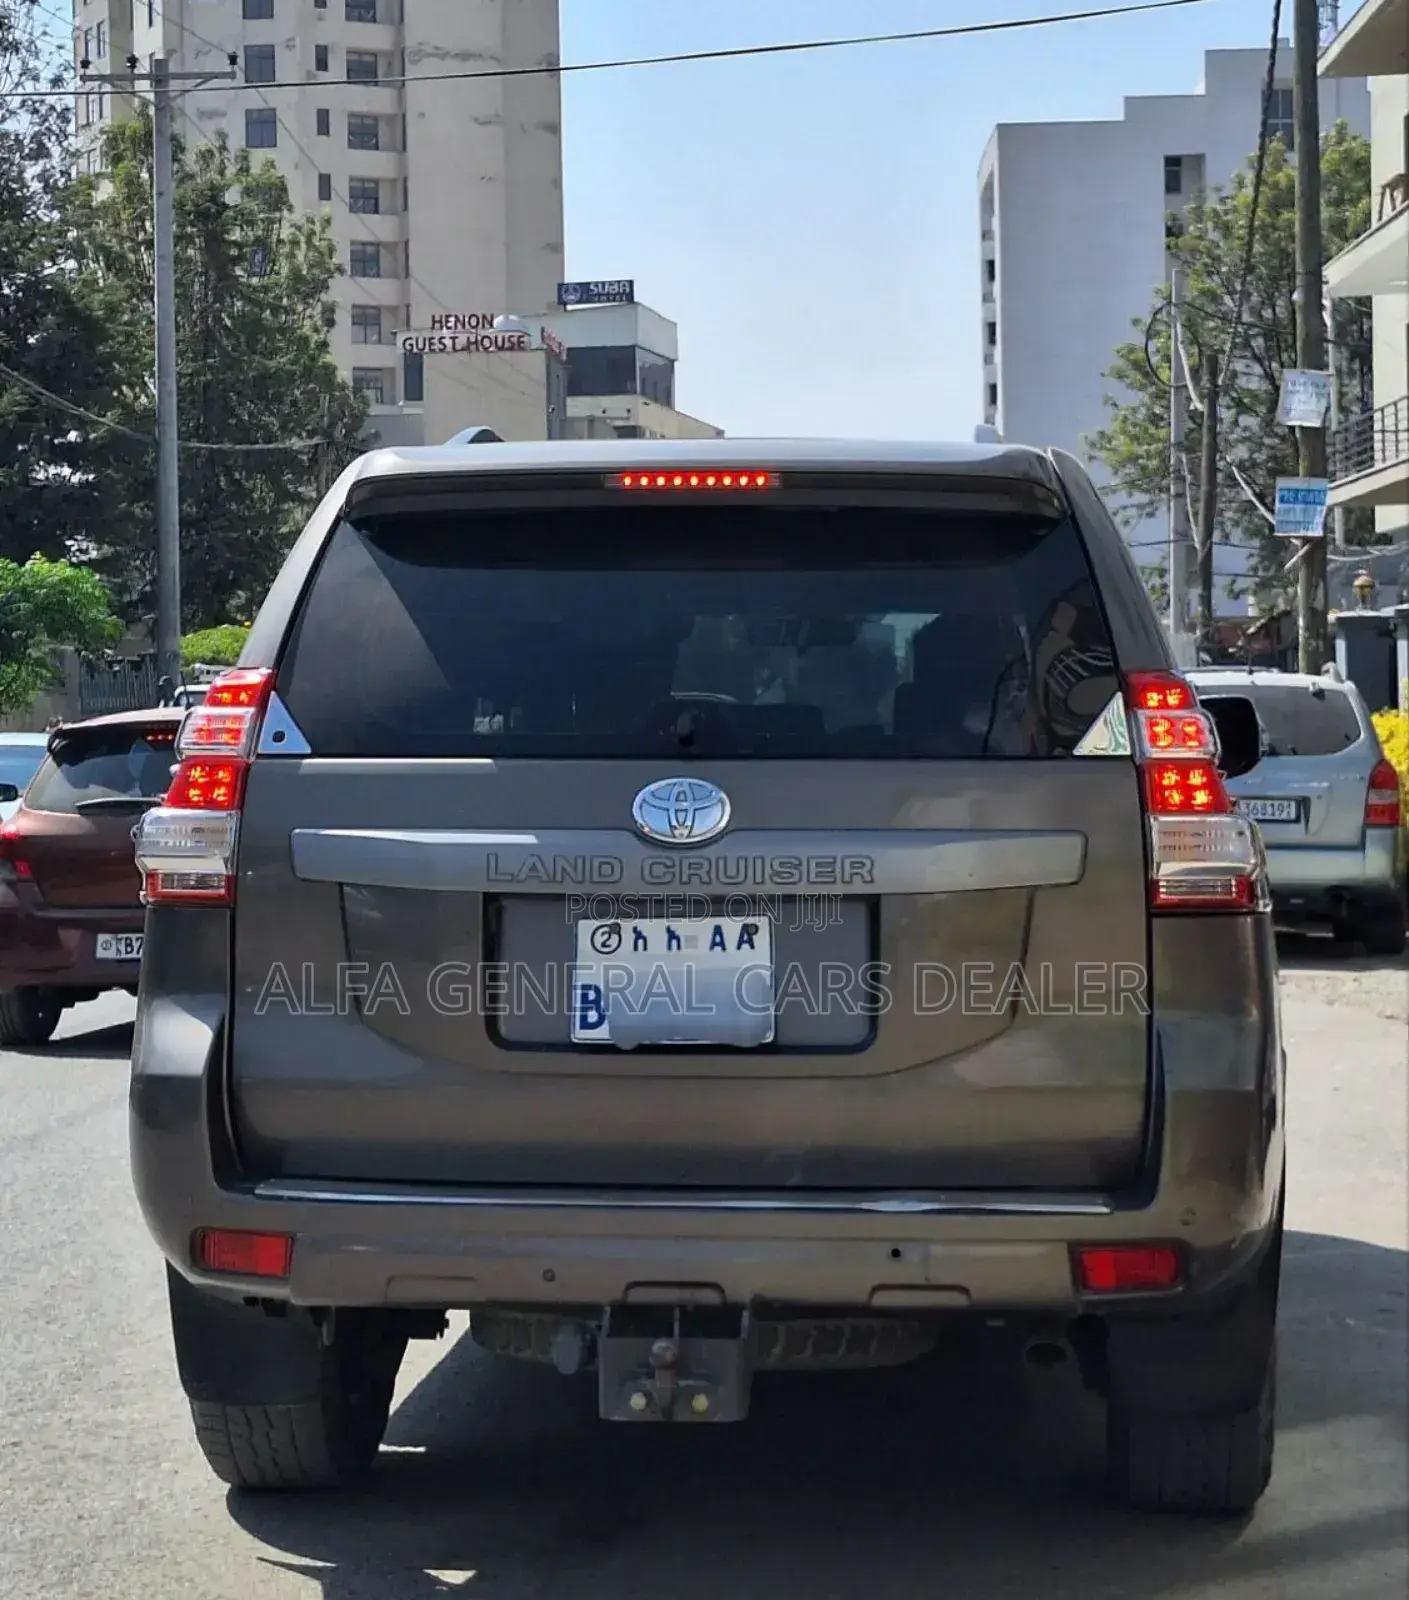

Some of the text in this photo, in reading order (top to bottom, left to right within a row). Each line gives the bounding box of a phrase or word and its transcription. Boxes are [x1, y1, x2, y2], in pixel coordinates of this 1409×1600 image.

[431, 313, 494, 330] HENON
[402, 335, 459, 352] GUEST
[467, 334, 526, 352] HOUSE
[486, 853, 875, 885] LAND CRUISER
